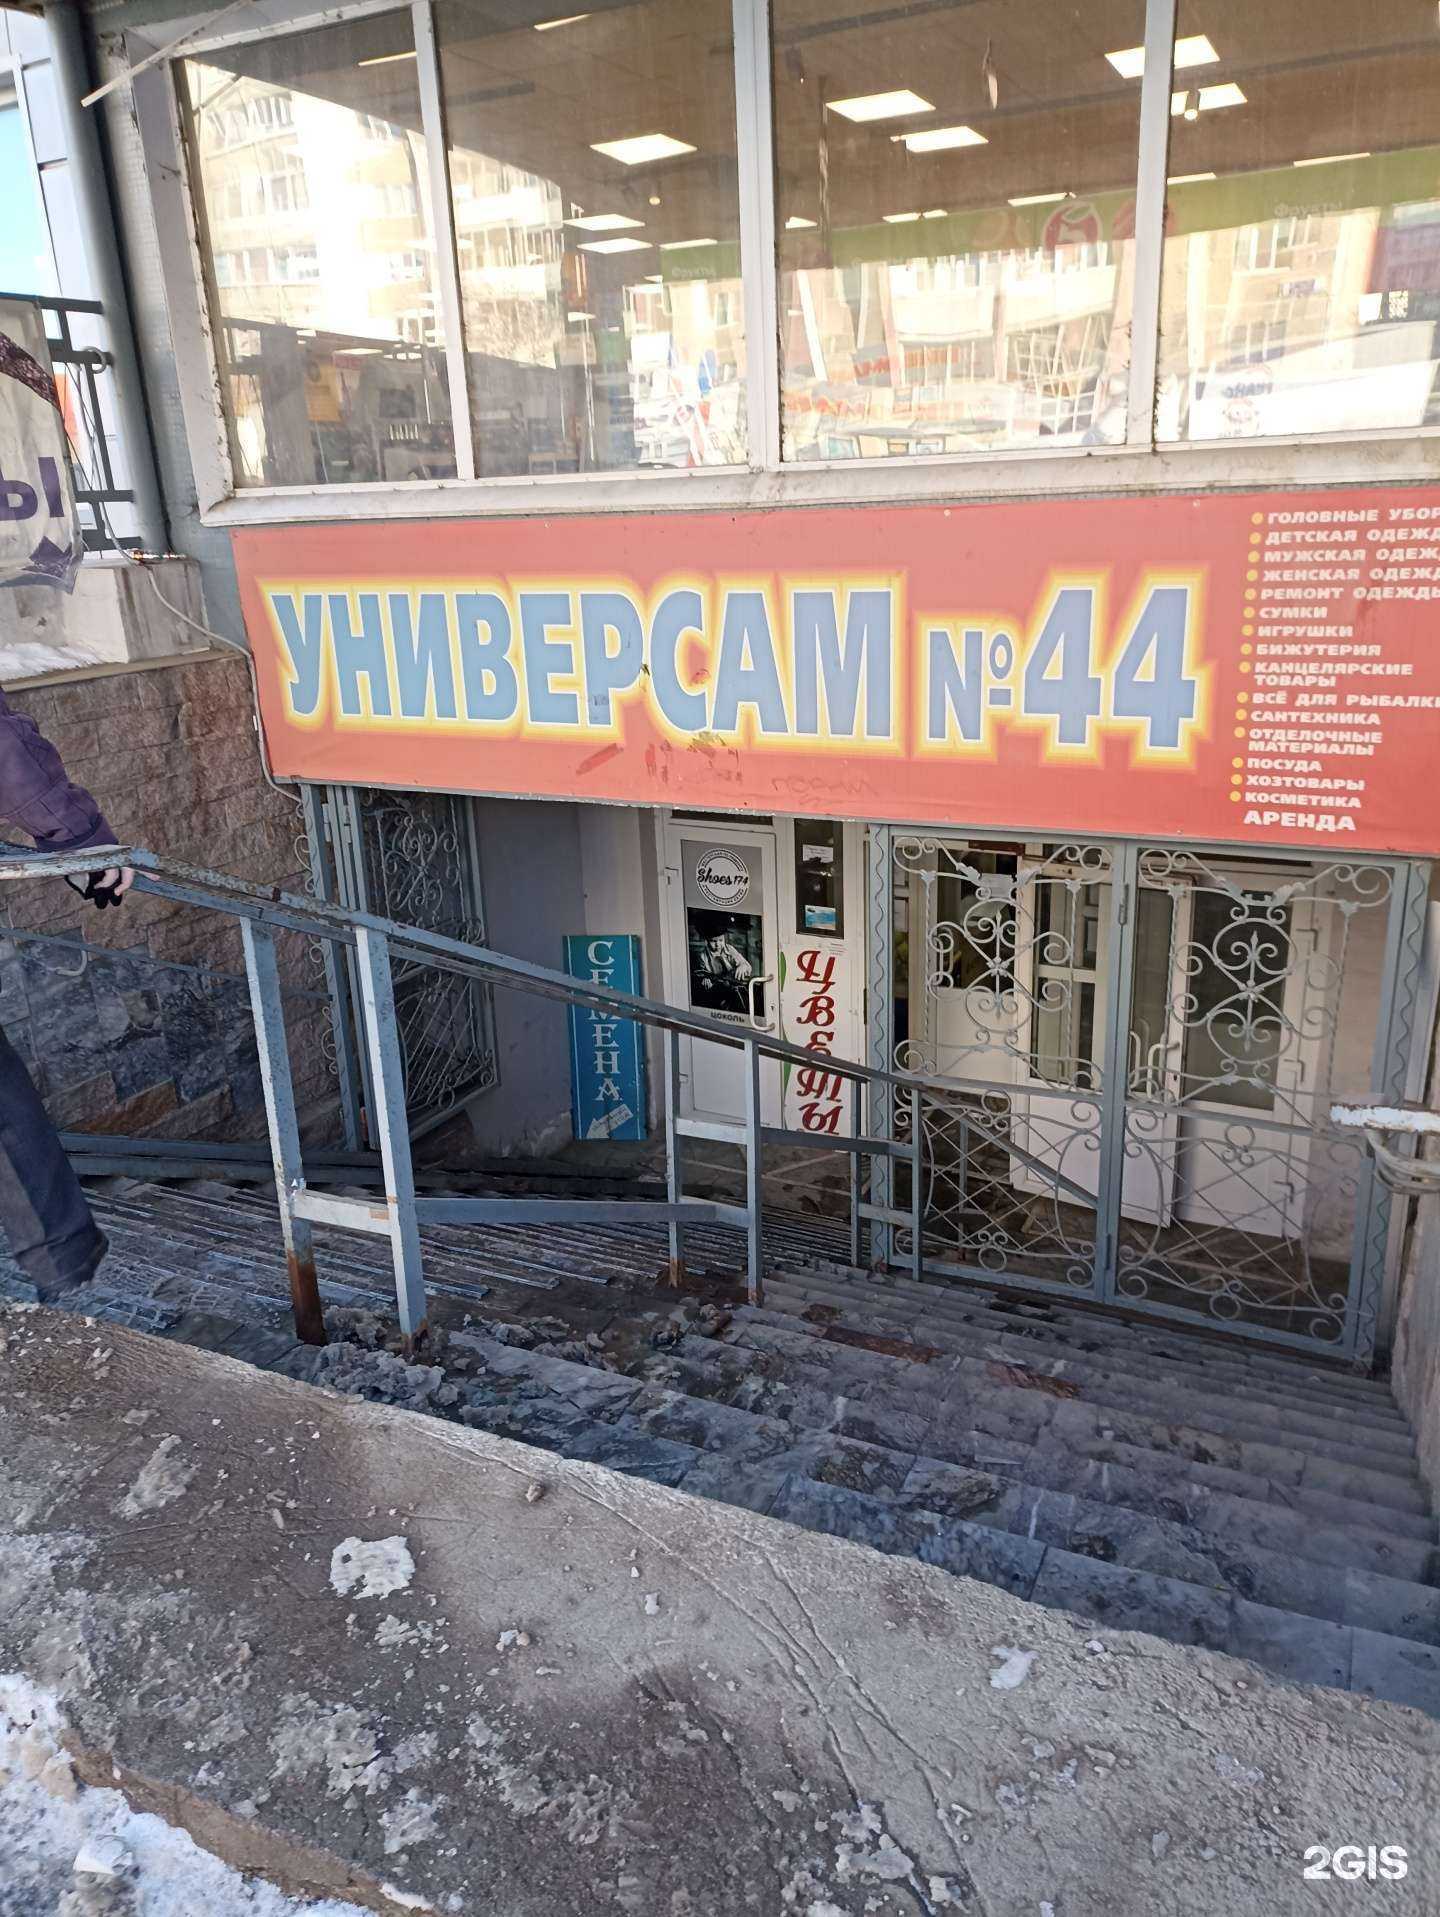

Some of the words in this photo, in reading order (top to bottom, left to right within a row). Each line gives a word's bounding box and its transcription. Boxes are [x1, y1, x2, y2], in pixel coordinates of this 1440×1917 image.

[1267, 509, 1379, 524] ГОЛОВНЫЕ
[1265, 530, 1358, 545] ДЕТСКАЯ
[1264, 549, 1366, 562] МУЖСКАЯ
[1376, 548, 1440, 562] ОДЕЖ
[1263, 568, 1360, 581] ЖЕНСКАЯ
[1261, 587, 1344, 600] РЕМОНТ
[1259, 606, 1328, 619] СУМКИ
[1257, 625, 1353, 637] ИГРУШКИ
[1256, 644, 1381, 656] БИЖУТЕРИЯ
[268, 585, 894, 739] УНИВЕРСАМ
[1255, 662, 1413, 675] КАНЦЕЛЯРСКИЕ
[1254, 675, 1336, 687] ТОВАРЫ
[1252, 690, 1287, 704] ВСЁ
[1295, 693, 1337, 706] ДЛЯ
[1250, 711, 1381, 725] САНТЕХНИКА
[1249, 728, 1383, 743] ОТДЕЛОЧНЫЕ
[1248, 741, 1375, 756] МАТЕРИАЛЫ
[1247, 758, 1322, 771] ПОСУДА
[1246, 775, 1365, 790] ХОЗТОВАРЫ
[1245, 792, 1361, 808] КОСМЕТИКА
[1244, 810, 1356, 832] АРЕНДА
[697, 868, 732, 885] Shoes
[733, 875, 749, 886] 174
[795, 950, 844, 1135] ЦВЕТЫ
